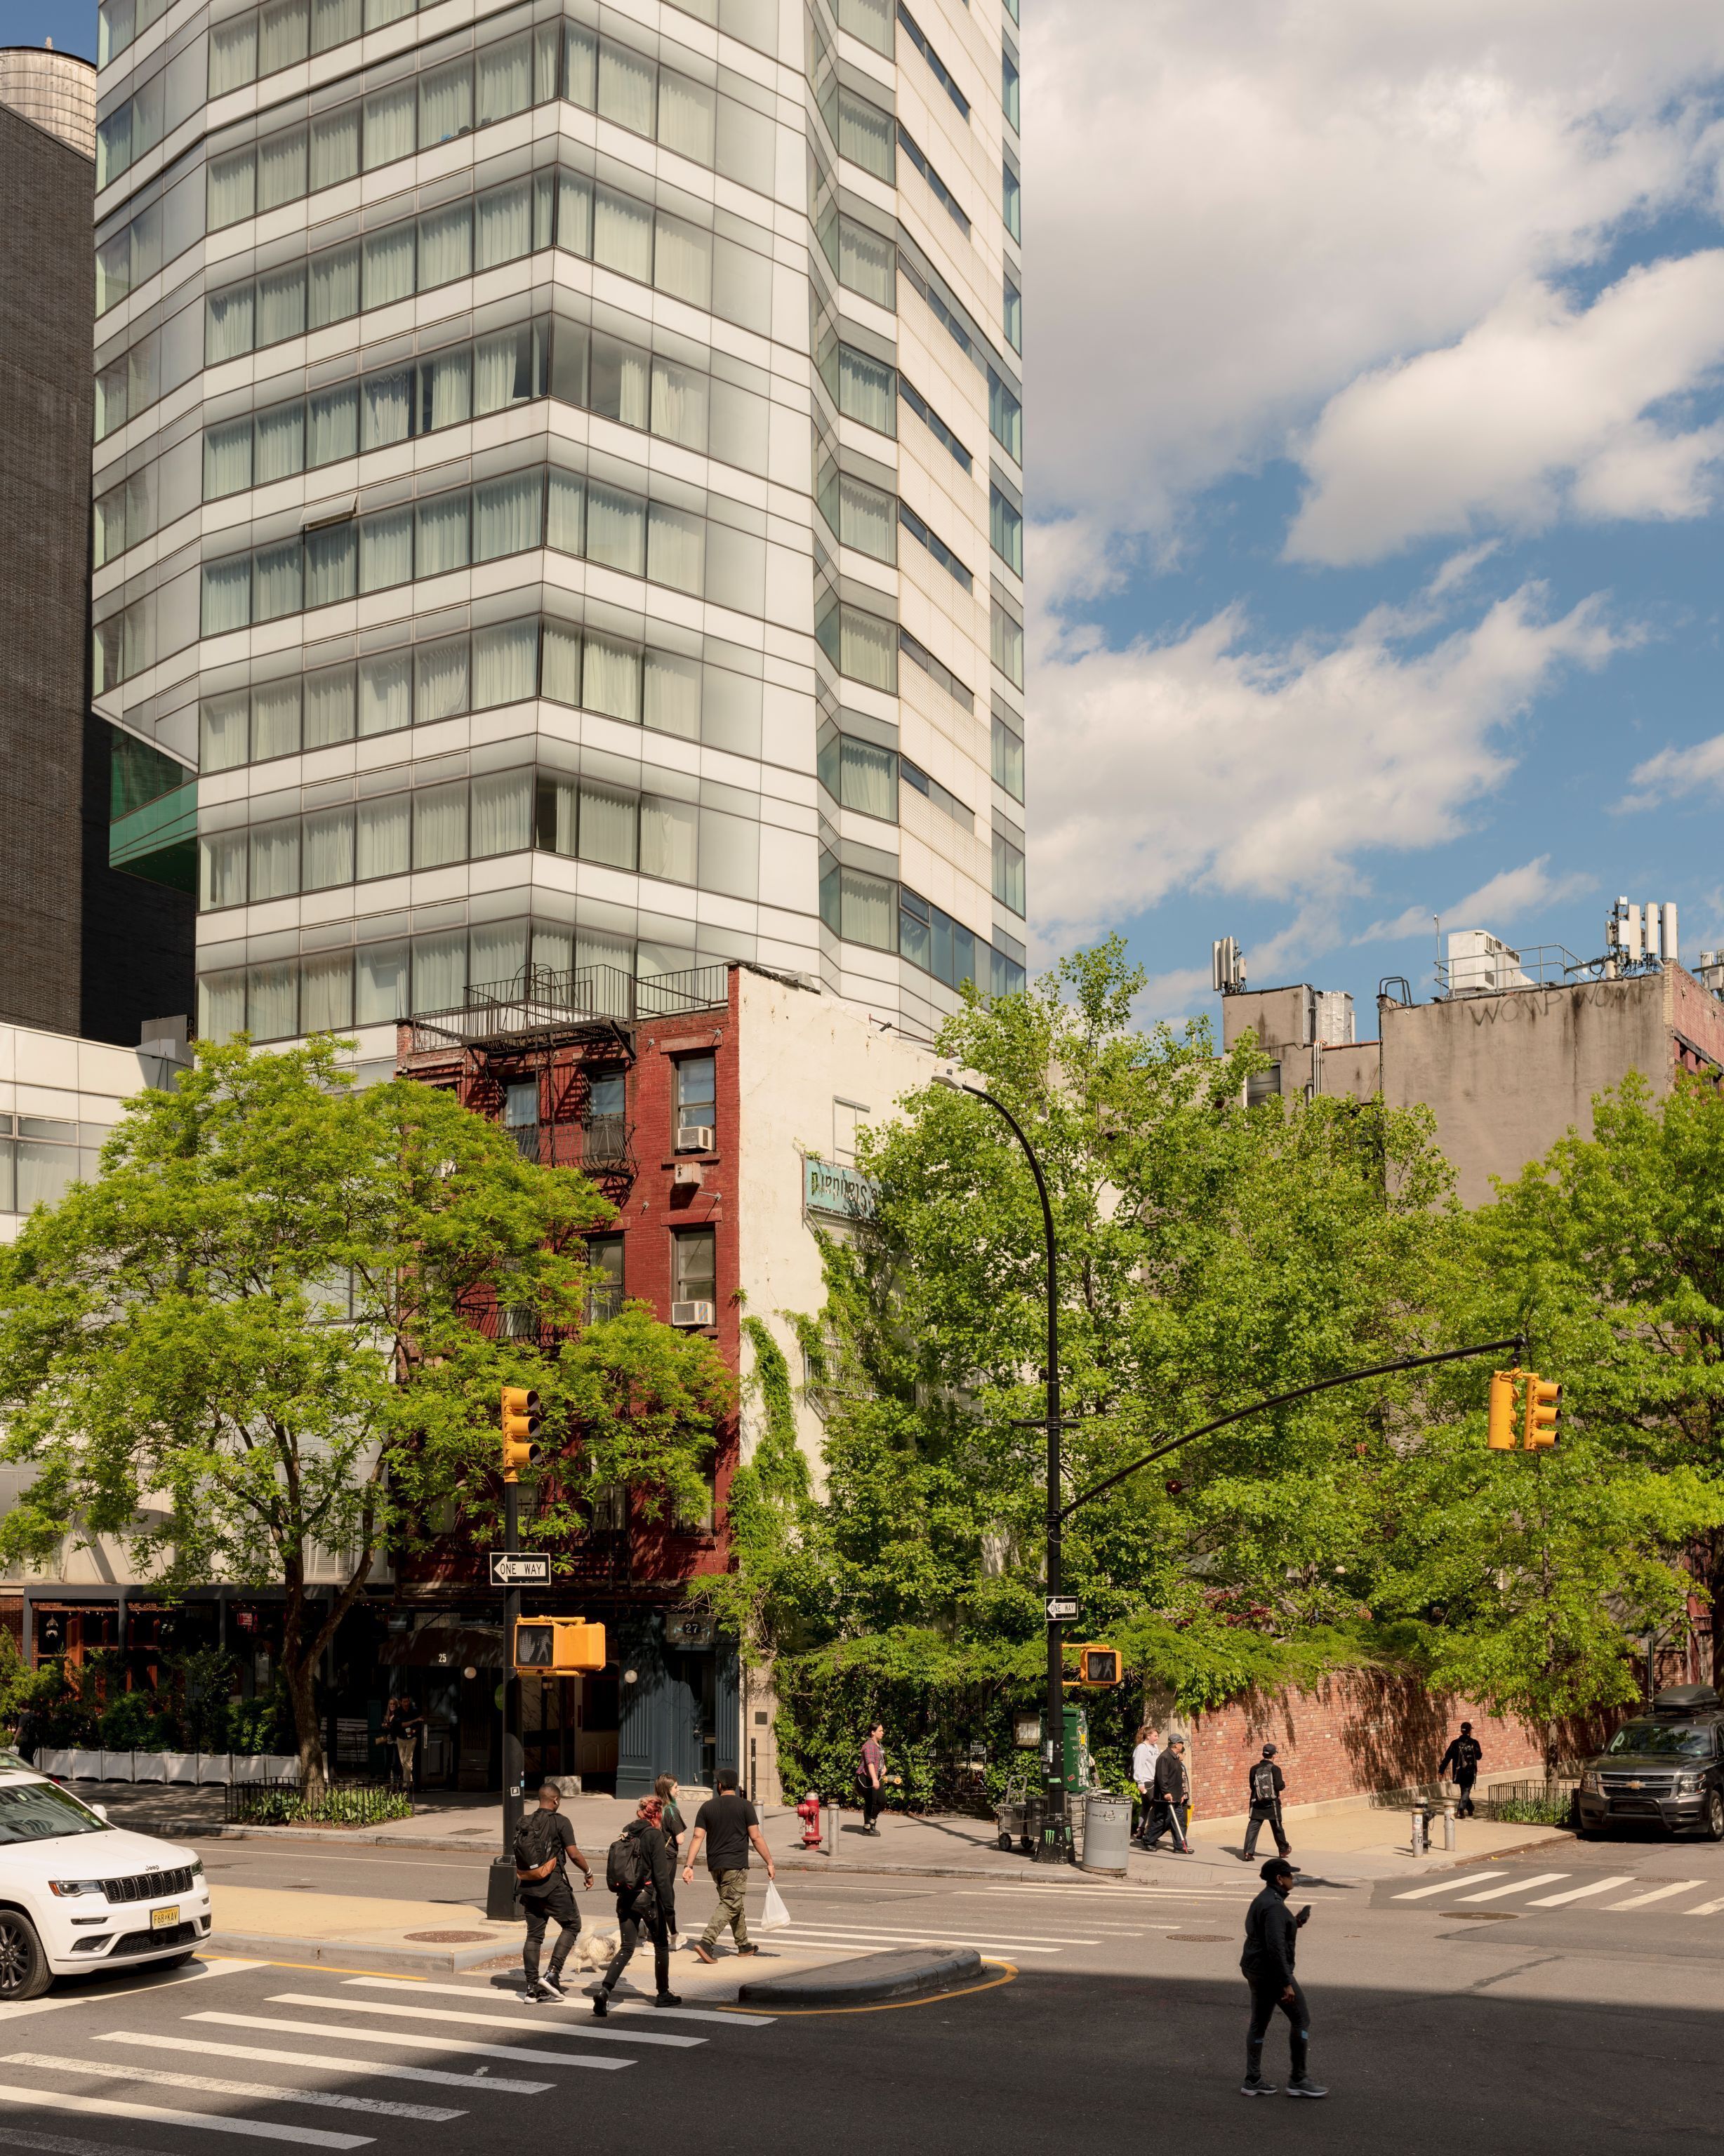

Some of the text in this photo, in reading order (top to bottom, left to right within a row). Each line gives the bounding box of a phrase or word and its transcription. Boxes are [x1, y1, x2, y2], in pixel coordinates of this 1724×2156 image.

[500, 1563, 542, 1575] ONE WAY
[1051, 1604, 1074, 1612] ONE WAY
[686, 1623, 698, 1633] 27
[439, 1653, 446, 1663] 25
